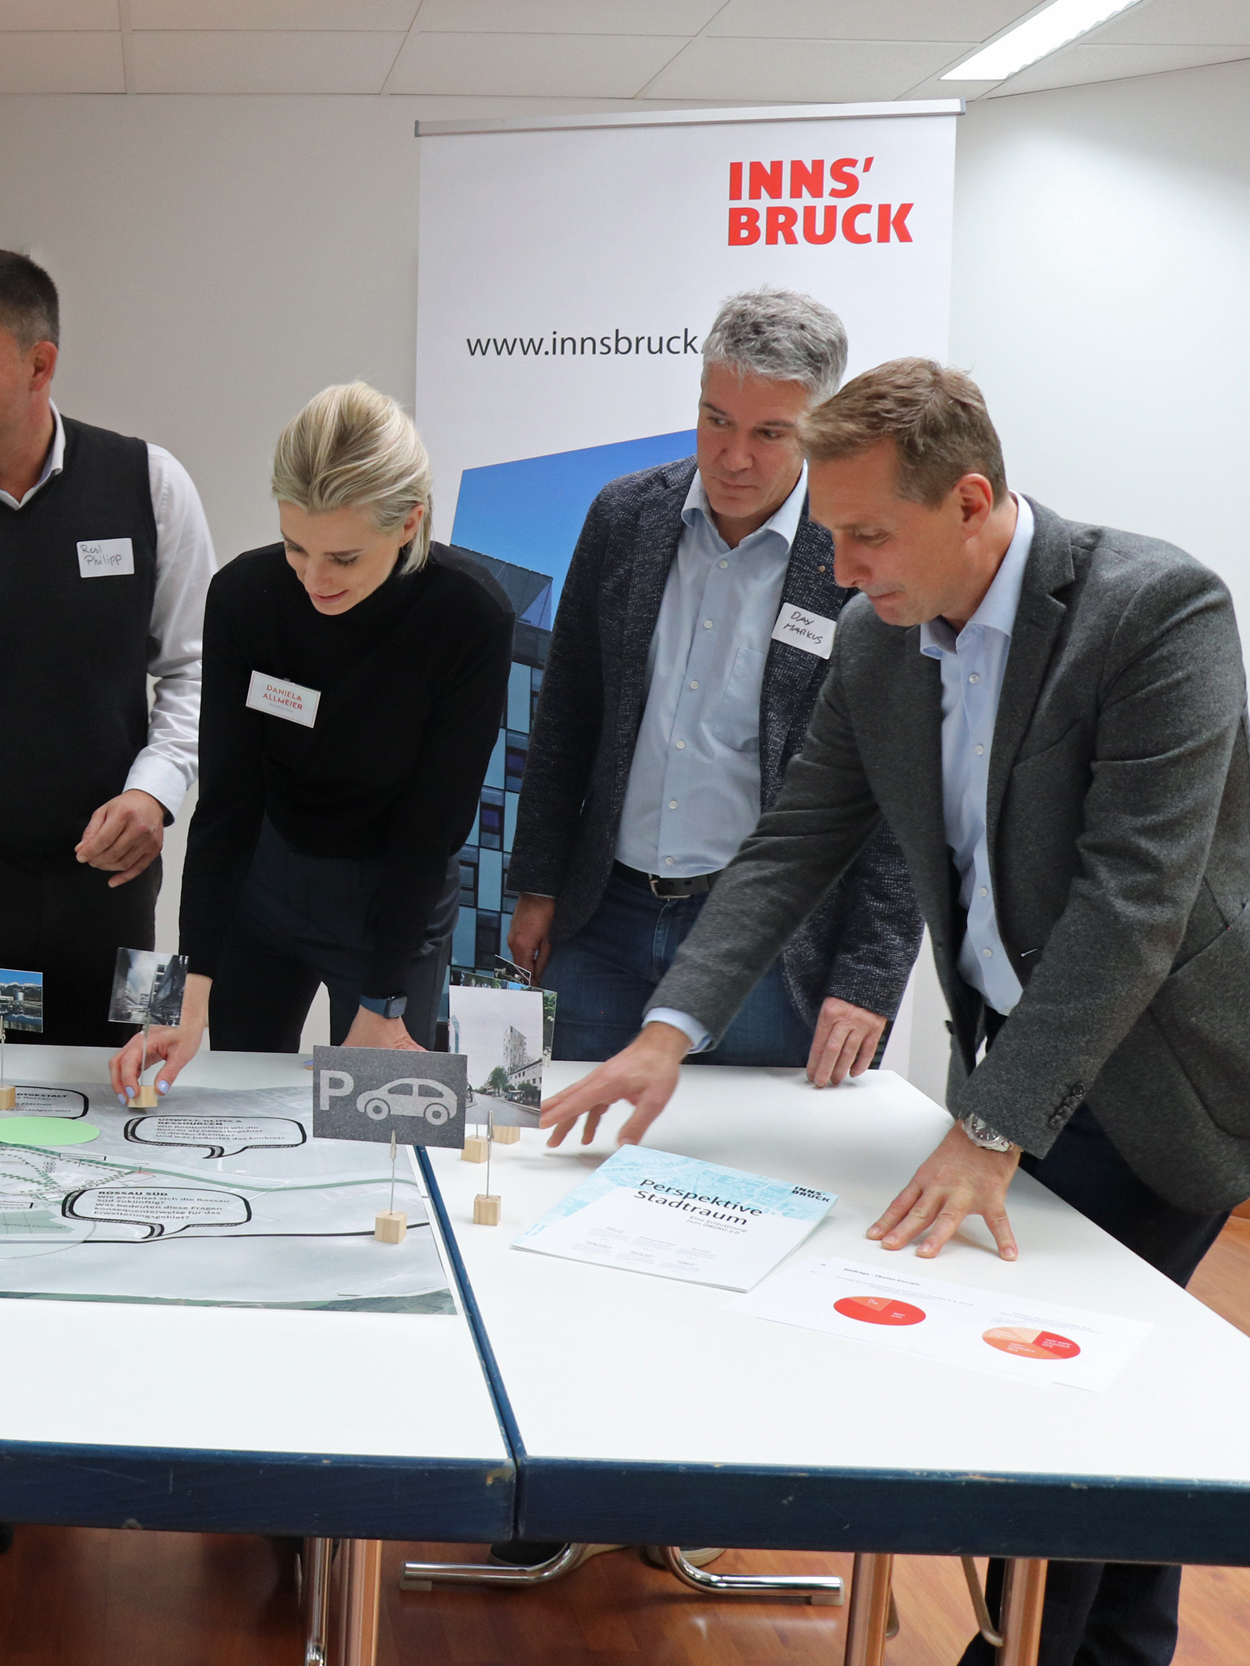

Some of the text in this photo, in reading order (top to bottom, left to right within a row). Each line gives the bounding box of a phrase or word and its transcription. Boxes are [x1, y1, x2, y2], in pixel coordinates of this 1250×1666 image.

[729, 156, 874, 201] INNS'
[727, 203, 915, 246] BRUCK
[84, 554, 122, 567] Philipp
[783, 623, 823, 644] MARKUS
[262, 693, 303, 710] ALLMEIER
[266, 684, 302, 701] DANIELA
[320, 1070, 354, 1110] P
[634, 1190, 747, 1226] Stadtraum
[640, 1179, 762, 1216] Perspektive
[792, 1190, 830, 1202] BRUCK
